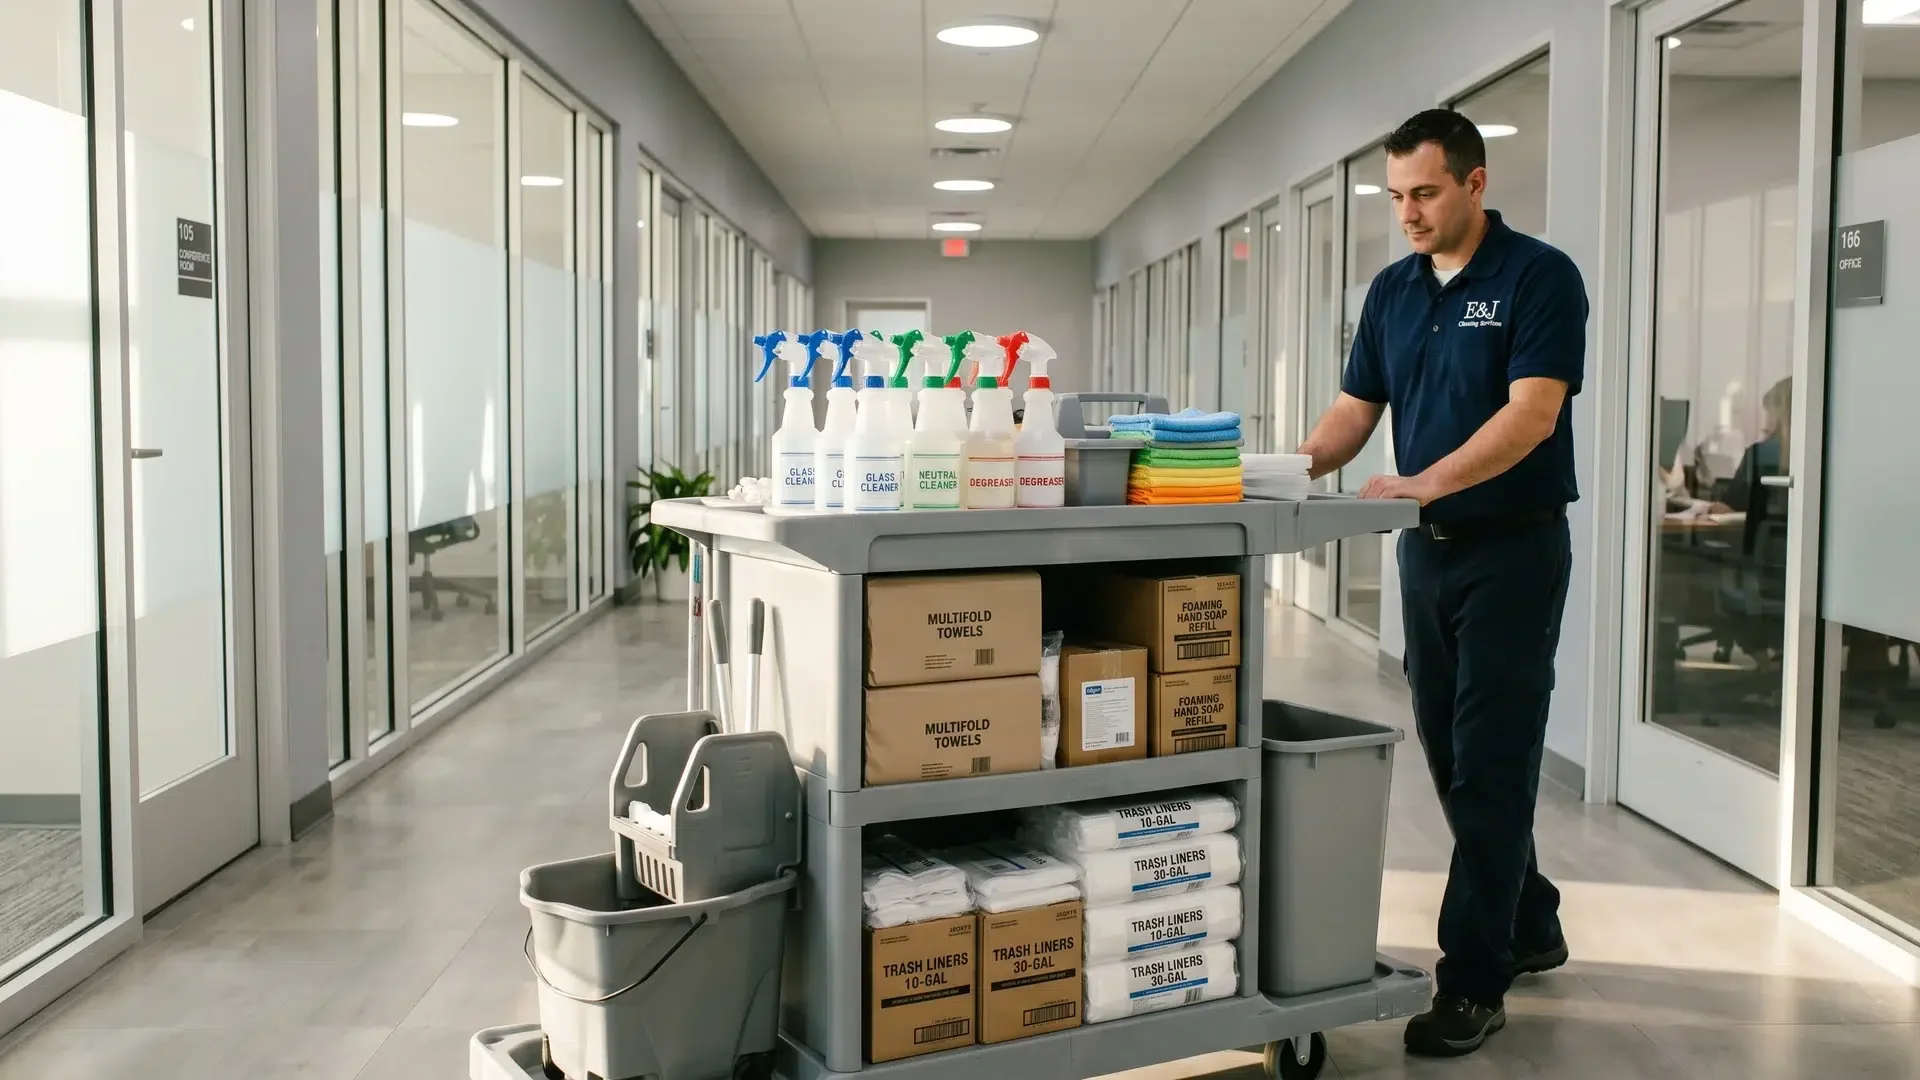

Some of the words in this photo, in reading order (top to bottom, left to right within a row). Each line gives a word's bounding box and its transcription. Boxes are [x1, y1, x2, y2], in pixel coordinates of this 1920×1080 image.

[179, 223, 194, 241] 105
[1839, 257, 1862, 270] OFFICE
[1463, 300, 1501, 320] E&J
[785, 477, 815, 486] CLEAN
[866, 473, 895, 482] GLASS
[918, 471, 957, 480] NEUTRAL
[860, 483, 899, 492] CLEANER
[919, 480, 957, 490] CLEANER
[1182, 600, 1223, 612] FOAMING
[927, 610, 992, 625] MULTIFOLD
[1177, 612, 1202, 623] HAND
[1204, 609, 1228, 621] SOAP
[936, 625, 983, 639] TOWELS
[1188, 620, 1217, 632] REFILL
[1179, 694, 1220, 706] FOAMING
[1174, 706, 1199, 718] HAND
[1201, 703, 1225, 715] SOAP
[925, 718, 990, 735] MULTIFOLD
[1185, 714, 1214, 727] REFILL
[934, 733, 982, 749] TOWELS
[1116, 806, 1153, 819] TRASH
[1153, 801, 1192, 814] LINERS
[1140, 814, 1176, 828] 10-GAL
[1134, 856, 1168, 872] TRASH
[1170, 849, 1206, 866] LINERS
[1153, 865, 1189, 881] 30-GAL
[1131, 916, 1165, 933] TRASH
[1167, 909, 1203, 926] LINERS
[1150, 926, 1186, 941] 10-GAL
[992, 943, 1031, 961] TRASH
[1034, 936, 1075, 955] LINERS
[882, 960, 923, 978] TRASH
[926, 952, 969, 972] LINERS
[1013, 956, 1055, 974] 30-GAL
[1131, 962, 1165, 979] TRASH
[1167, 954, 1203, 972] LINERS
[904, 972, 948, 990] 10-GAL
[1150, 970, 1188, 987] 30-GAL
